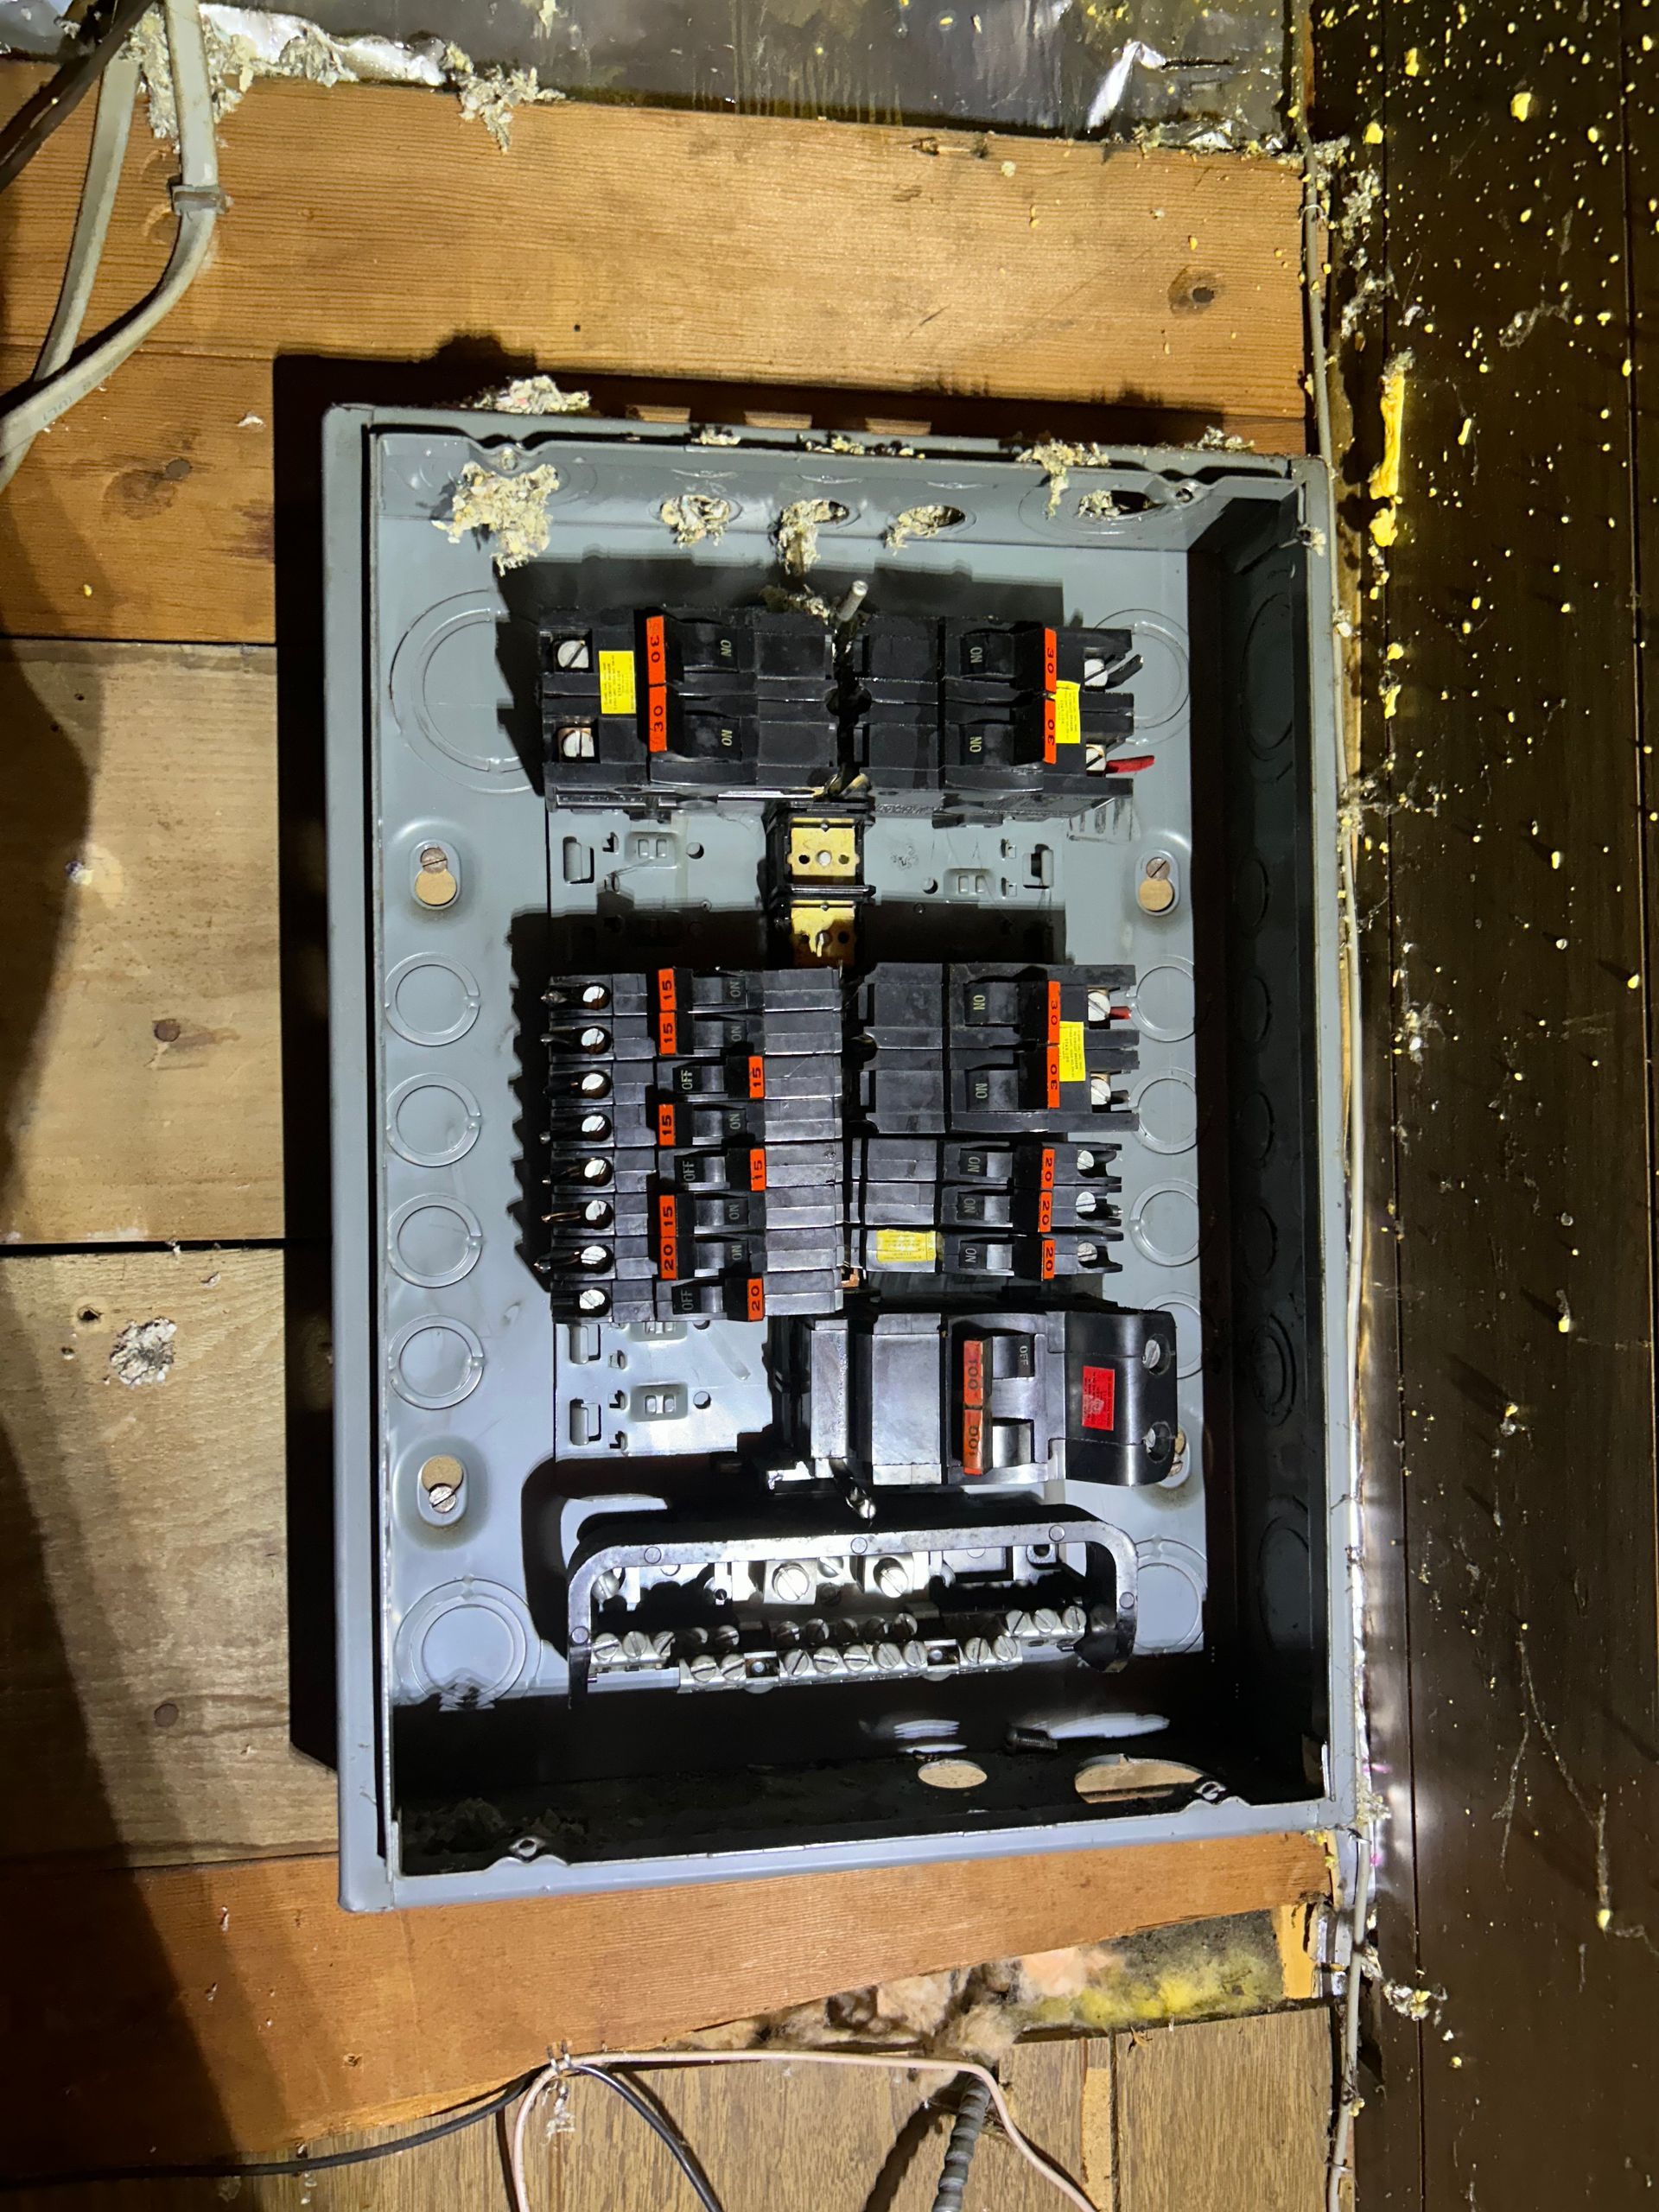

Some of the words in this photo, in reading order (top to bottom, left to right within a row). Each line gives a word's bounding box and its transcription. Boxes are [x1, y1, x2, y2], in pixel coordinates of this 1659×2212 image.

[651, 636, 660, 663] 30
[721, 639, 732, 657] ON
[969, 646, 982, 664] ON
[1046, 648, 1054, 673] 30
[653, 704, 664, 733] 30
[721, 729, 733, 746] ON
[1048, 720, 1055, 746] 30
[969, 736, 982, 753] ON
[662, 979, 672, 1001] 15
[730, 980, 741, 997] ON
[973, 995, 985, 1010] ON
[1051, 1001, 1058, 1026] 30
[662, 1023, 672, 1045] 15
[730, 1025, 741, 1042] ON
[681, 1070, 693, 1090] OFF
[752, 1066, 762, 1087] 15
[1051, 1066, 1058, 1090] 30
[976, 1084, 987, 1099] ON
[662, 1115, 672, 1136] 15
[728, 1113, 740, 1130] ON
[683, 1160, 696, 1181] OFF
[753, 1160, 763, 1181] 15
[968, 1156, 980, 1173] ON
[1045, 1157, 1052, 1182] 20
[729, 1203, 740, 1220] ON
[965, 1198, 976, 1214] ON
[1041, 1200, 1050, 1226] 20
[663, 1206, 673, 1228] 15
[663, 1244, 674, 1271] 20
[732, 1243, 742, 1260] ON
[965, 1248, 977, 1263] ON
[1046, 1248, 1053, 1272] 20
[682, 1290, 693, 1312] OFF
[752, 1285, 760, 1311] 20
[1020, 1345, 1029, 1366] OFF
